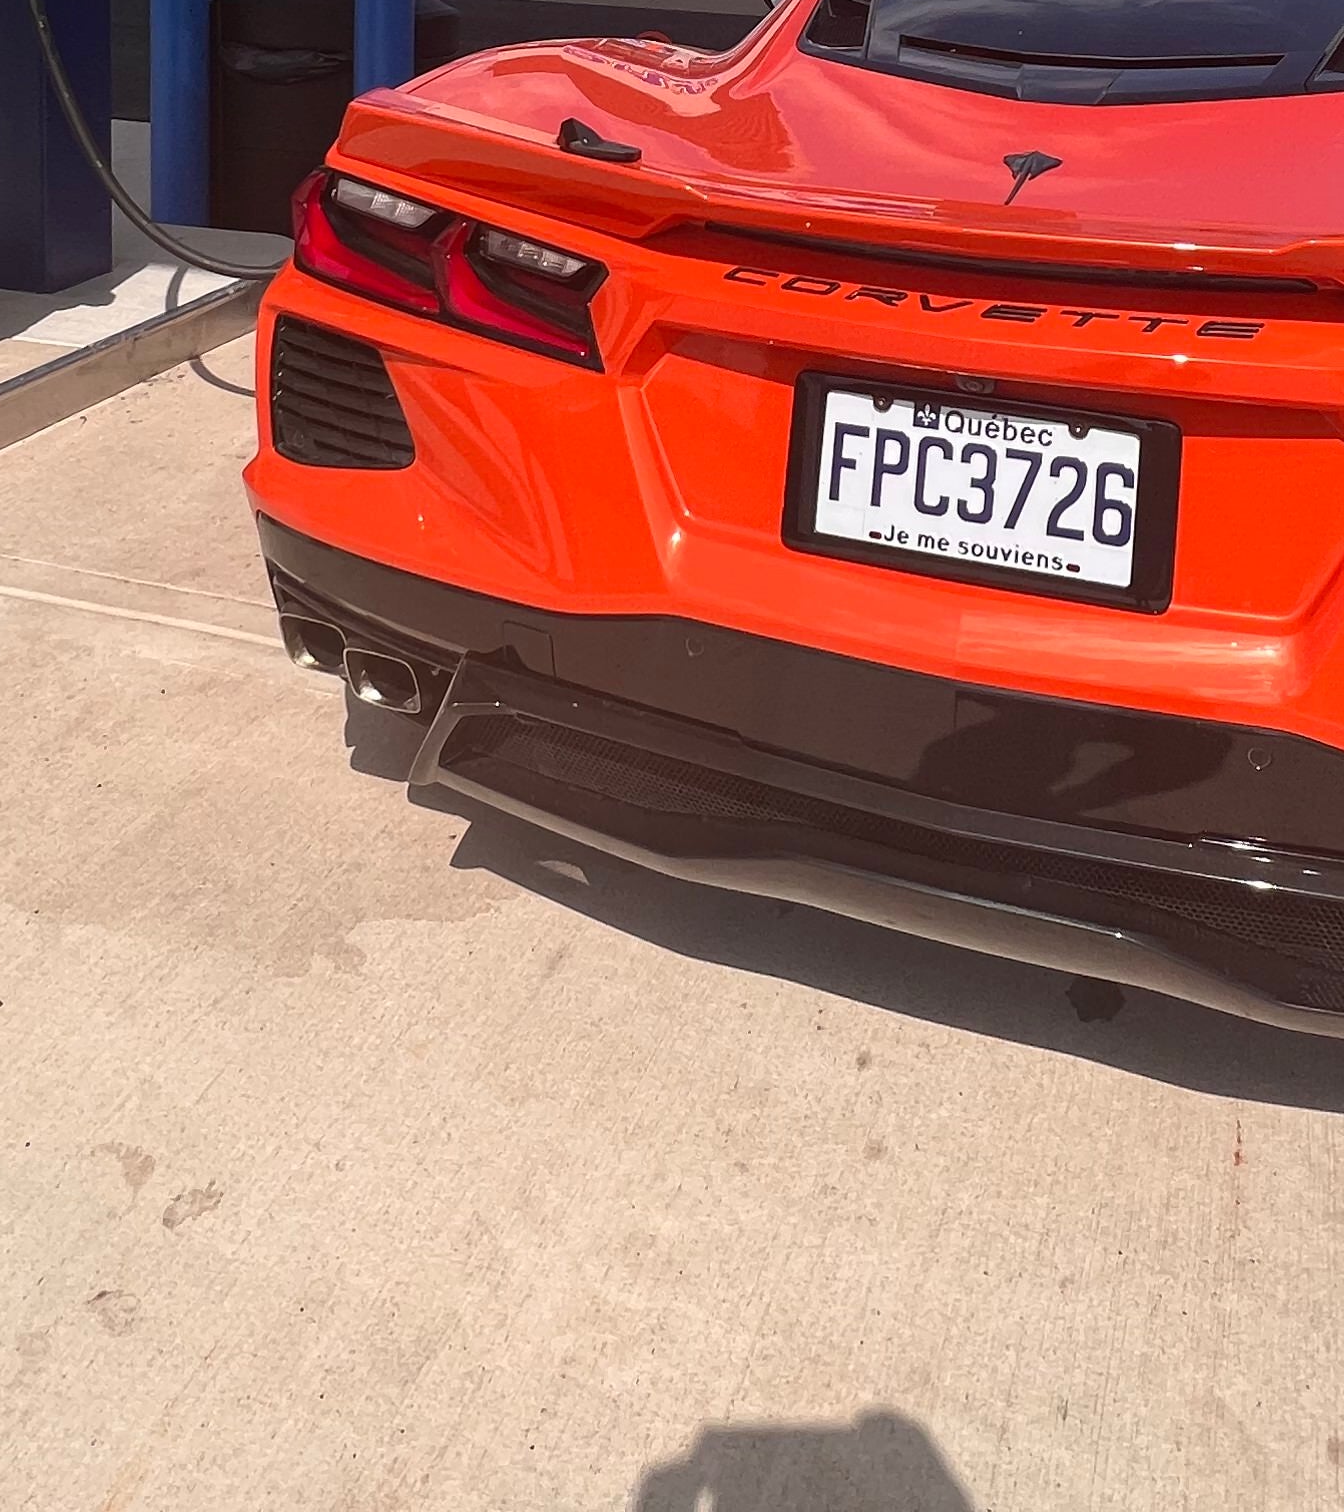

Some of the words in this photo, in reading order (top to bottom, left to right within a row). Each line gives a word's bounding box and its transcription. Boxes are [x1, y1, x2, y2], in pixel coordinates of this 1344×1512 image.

[723, 265, 1265, 339] CORVETTE
[944, 409, 1054, 449] Québec
[828, 421, 1136, 547] FPC3726
[883, 523, 913, 546] Je
[917, 531, 951, 552] me
[957, 539, 1065, 572] souviens
